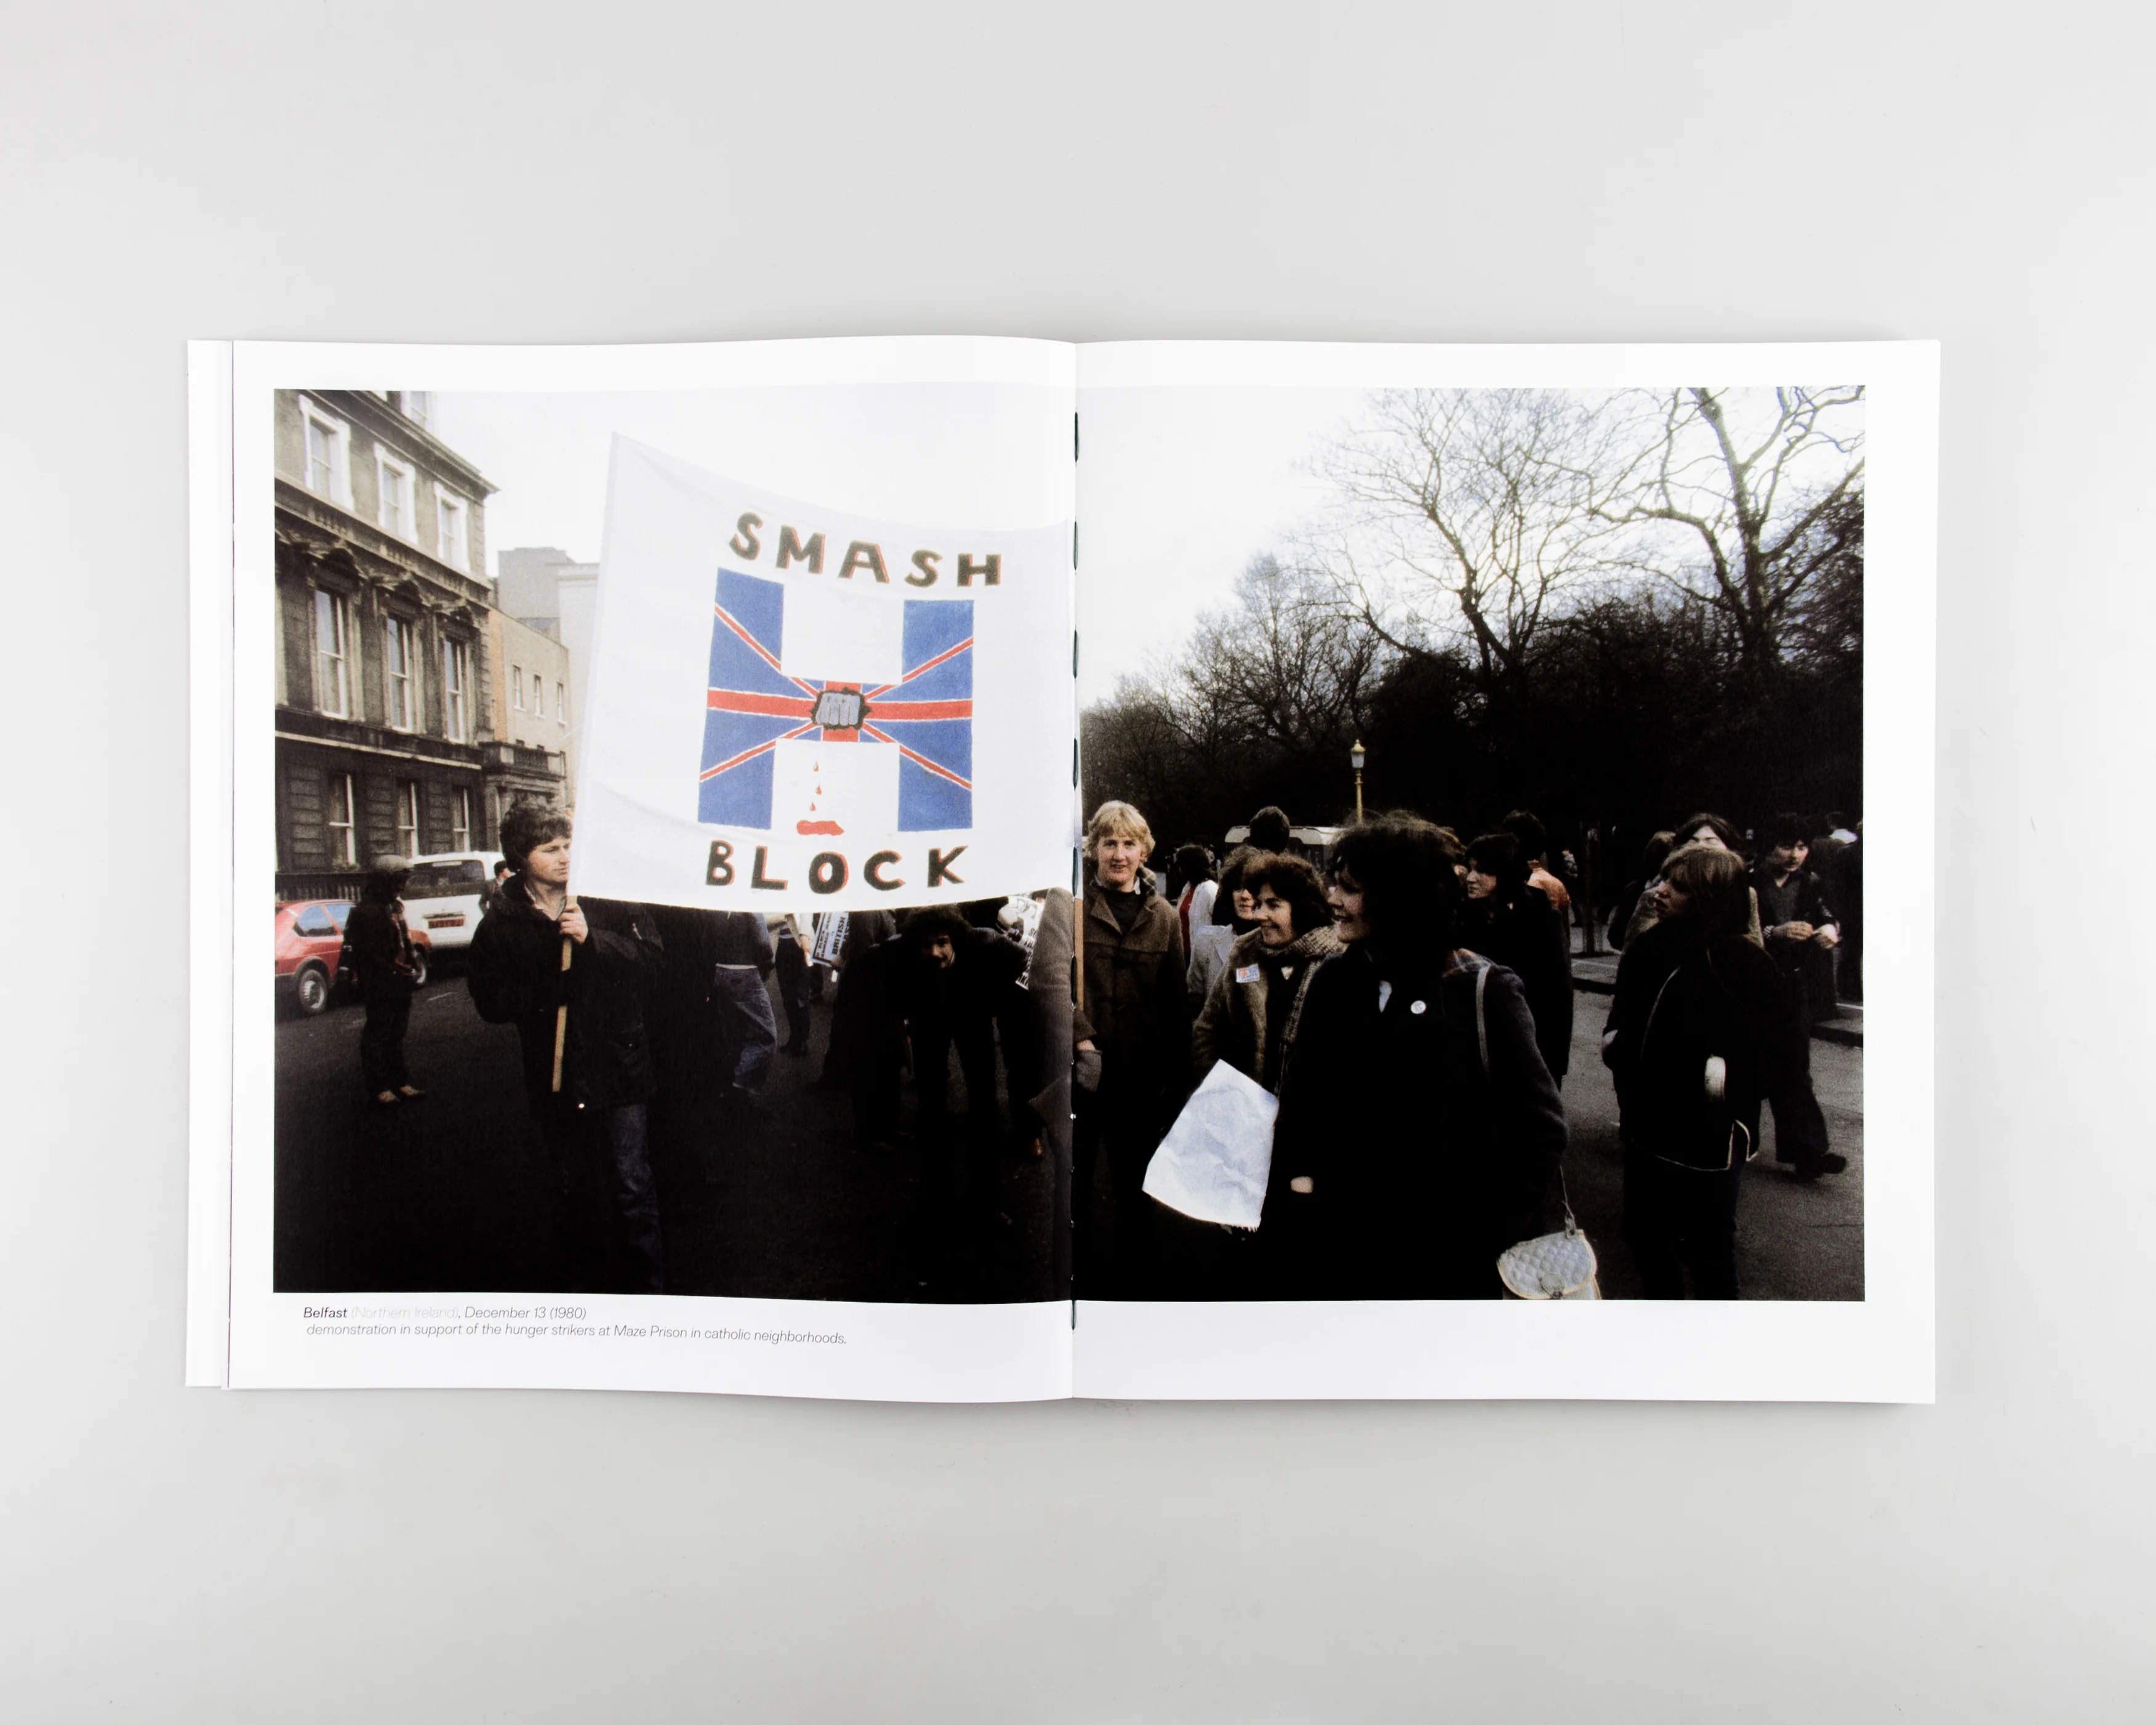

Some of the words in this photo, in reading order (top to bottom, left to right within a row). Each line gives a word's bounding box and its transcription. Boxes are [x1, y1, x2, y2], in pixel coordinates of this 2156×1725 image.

[729, 512, 1002, 588] SMASH
[697, 567, 974, 832] H
[705, 840, 969, 895] BLOCK
[832, 916, 846, 955] BRITISH
[303, 1306, 348, 1319] Belfast
[351, 1306, 411, 1319] (Northern
[414, 1306, 461, 1319] Ireland),
[464, 1306, 531, 1319] December
[534, 1306, 547, 1319] 13
[549, 1306, 587, 1321] (1980)
[306, 1323, 397, 1335] demonstration
[399, 1323, 411, 1335] in
[414, 1324, 463, 1338] support
[465, 1322, 480, 1335] of
[482, 1322, 502, 1335] the
[505, 1322, 549, 1338] hunger
[551, 1323, 596, 1337] strikers
[598, 1325, 611, 1337] at
[613, 1324, 647, 1337] Maze
[649, 1325, 687, 1338] Prison
[690, 1327, 701, 1339] in
[703, 1327, 751, 1341] catholic
[753, 1329, 847, 1345] neighborhoods.
